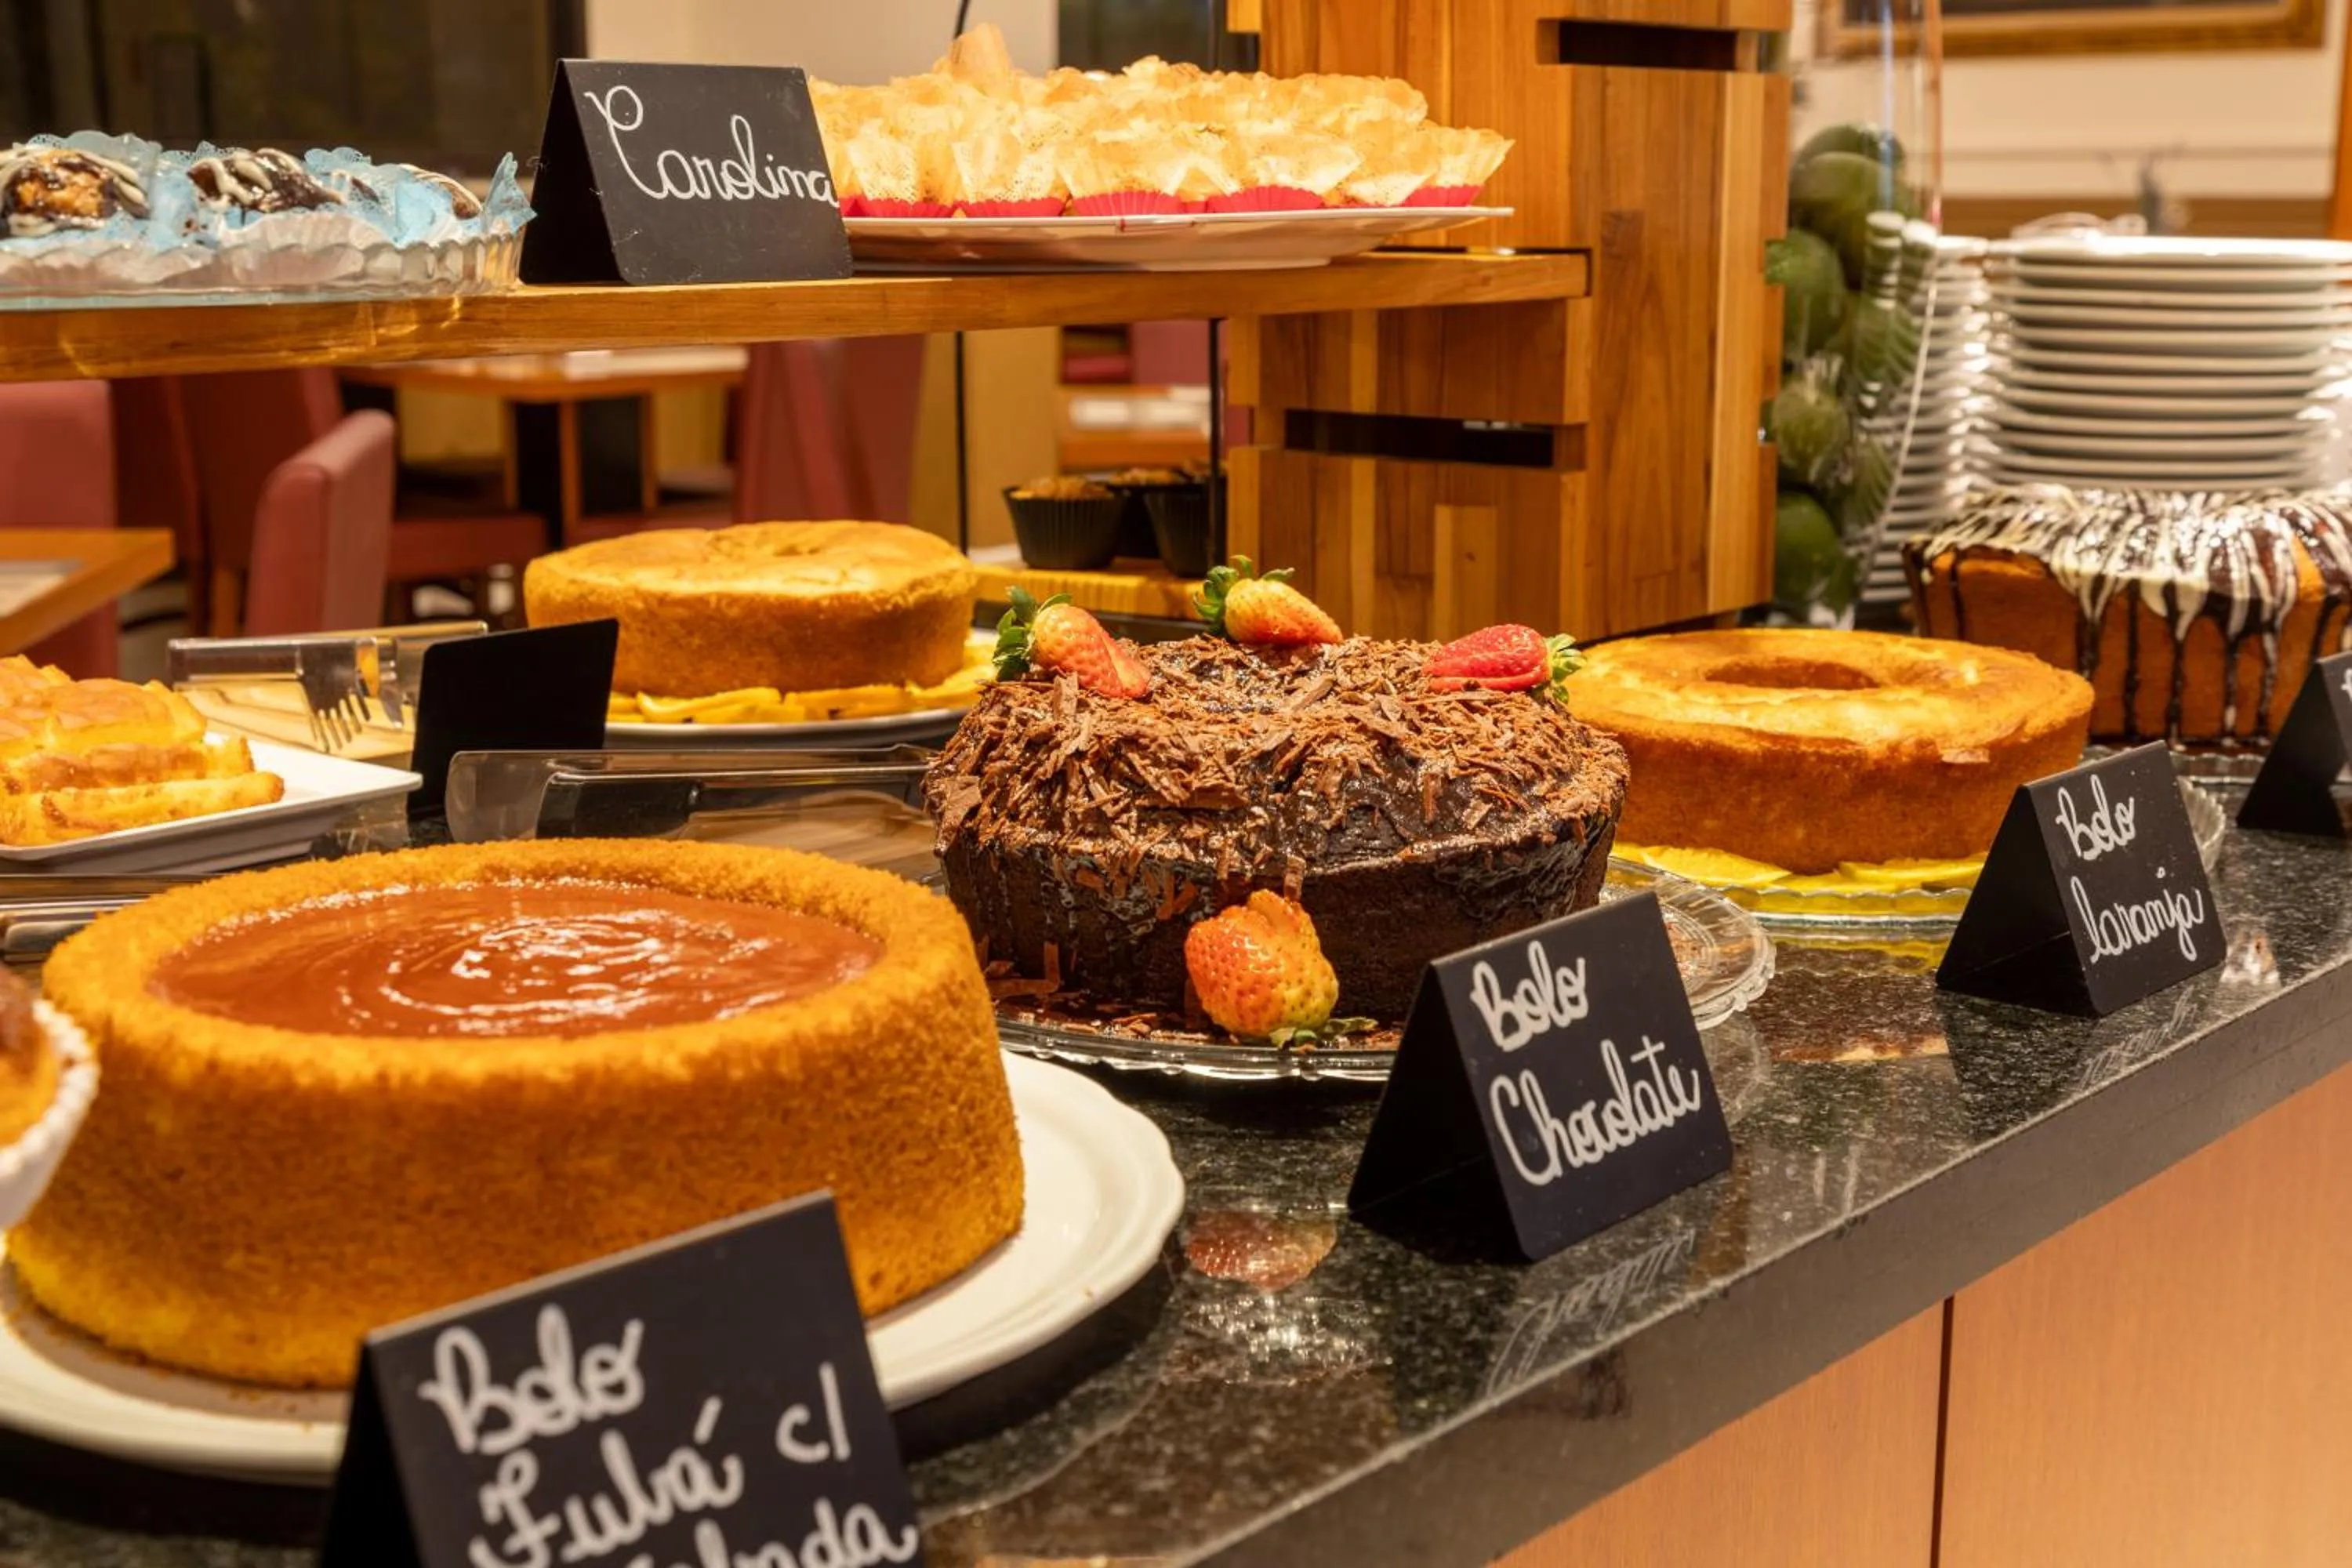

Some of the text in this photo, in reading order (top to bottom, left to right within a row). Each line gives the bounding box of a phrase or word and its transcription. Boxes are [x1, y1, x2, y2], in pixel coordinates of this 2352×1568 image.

[584, 85, 840, 208] Carolina
[1469, 940, 1590, 1052] Bolo
[1490, 1035, 1701, 1187] Chocolate
[417, 1302, 646, 1455] Bolo
[468, 1396, 745, 1568] Fubá
